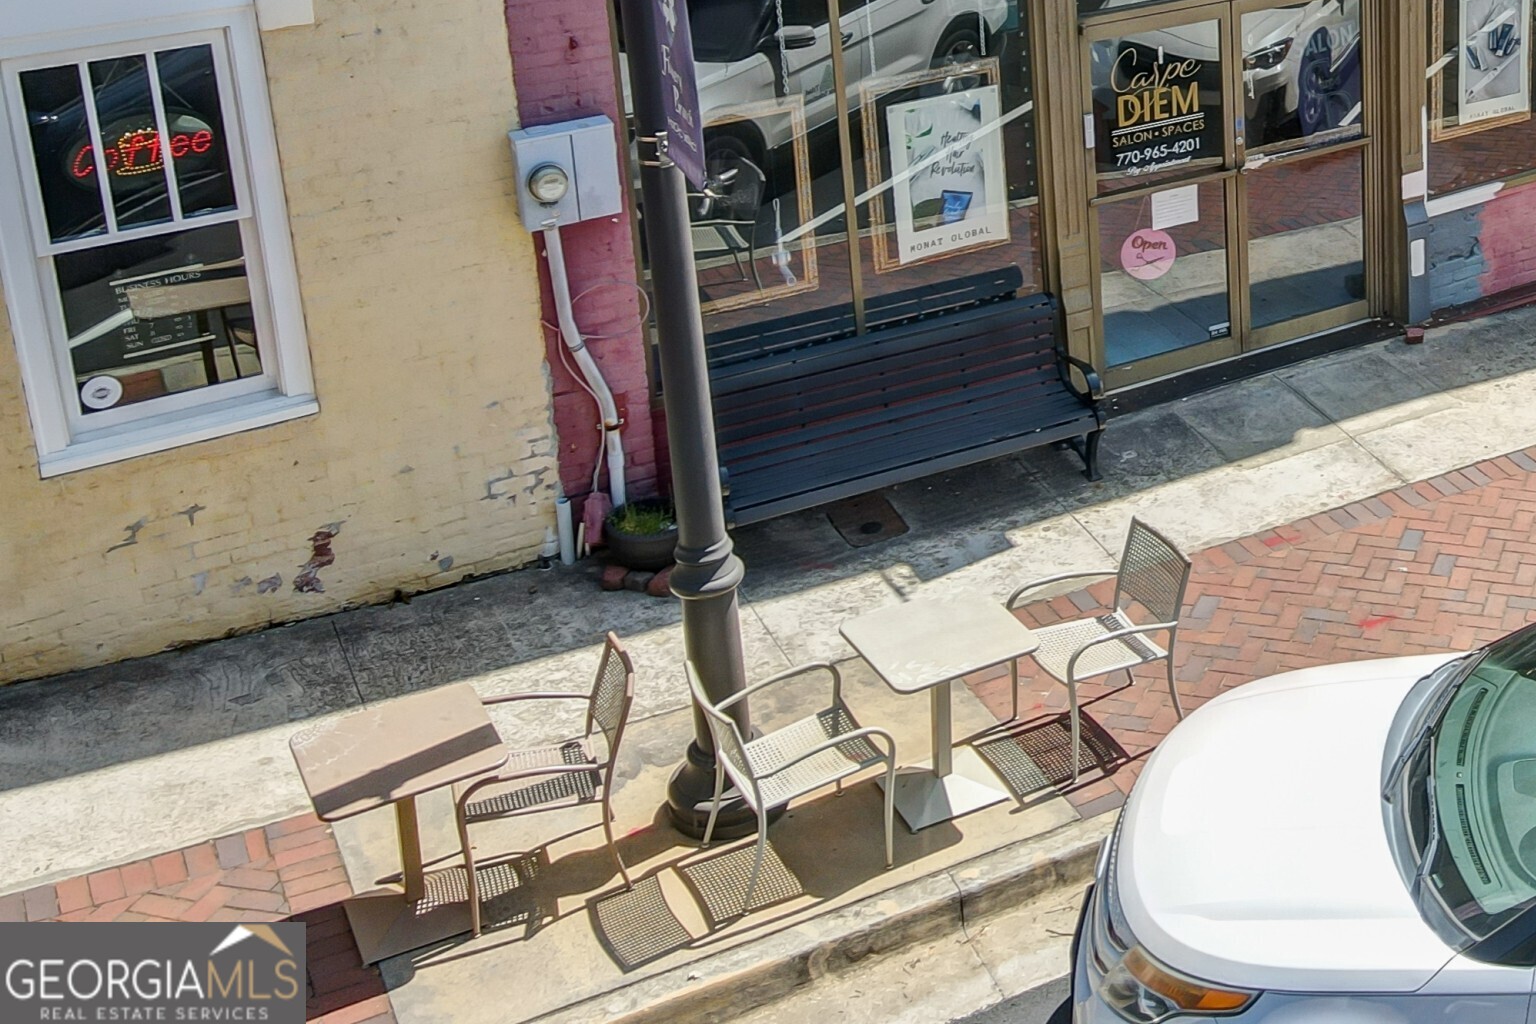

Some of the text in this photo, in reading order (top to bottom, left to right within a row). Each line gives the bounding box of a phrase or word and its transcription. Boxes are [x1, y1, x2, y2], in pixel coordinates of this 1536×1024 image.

[1110, 47, 1202, 95] Carpe
[1117, 81, 1199, 127] DIEM
[1112, 119, 1205, 148] SALON SPACES
[1115, 137, 1200, 167] 770-965-4201
[1131, 235, 1168, 251] Open
[165, 272, 202, 285] HOURS
